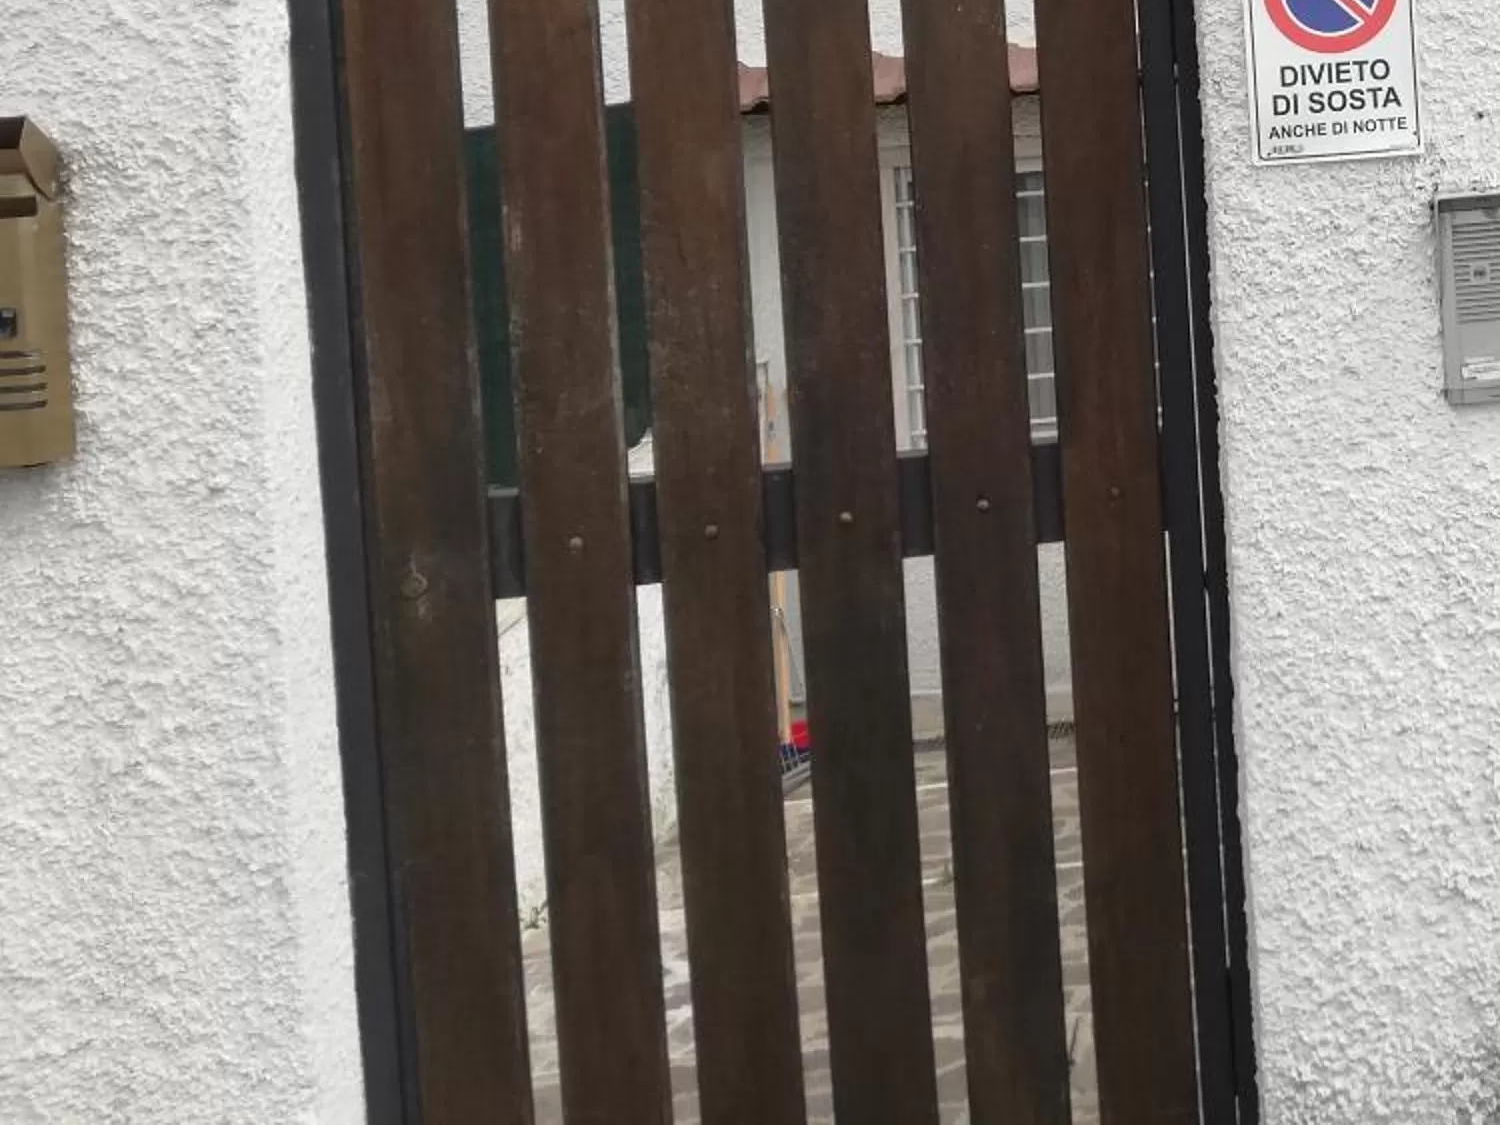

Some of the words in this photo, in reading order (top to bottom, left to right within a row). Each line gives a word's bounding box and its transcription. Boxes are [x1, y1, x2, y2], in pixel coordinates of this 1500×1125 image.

[1279, 58, 1390, 87] DIVIETO
[1272, 93, 1299, 116] DI
[1308, 86, 1402, 114] SOSTA
[1268, 122, 1327, 140] ANCHE
[1332, 120, 1348, 135] DI
[1353, 116, 1408, 134] NOTTE
